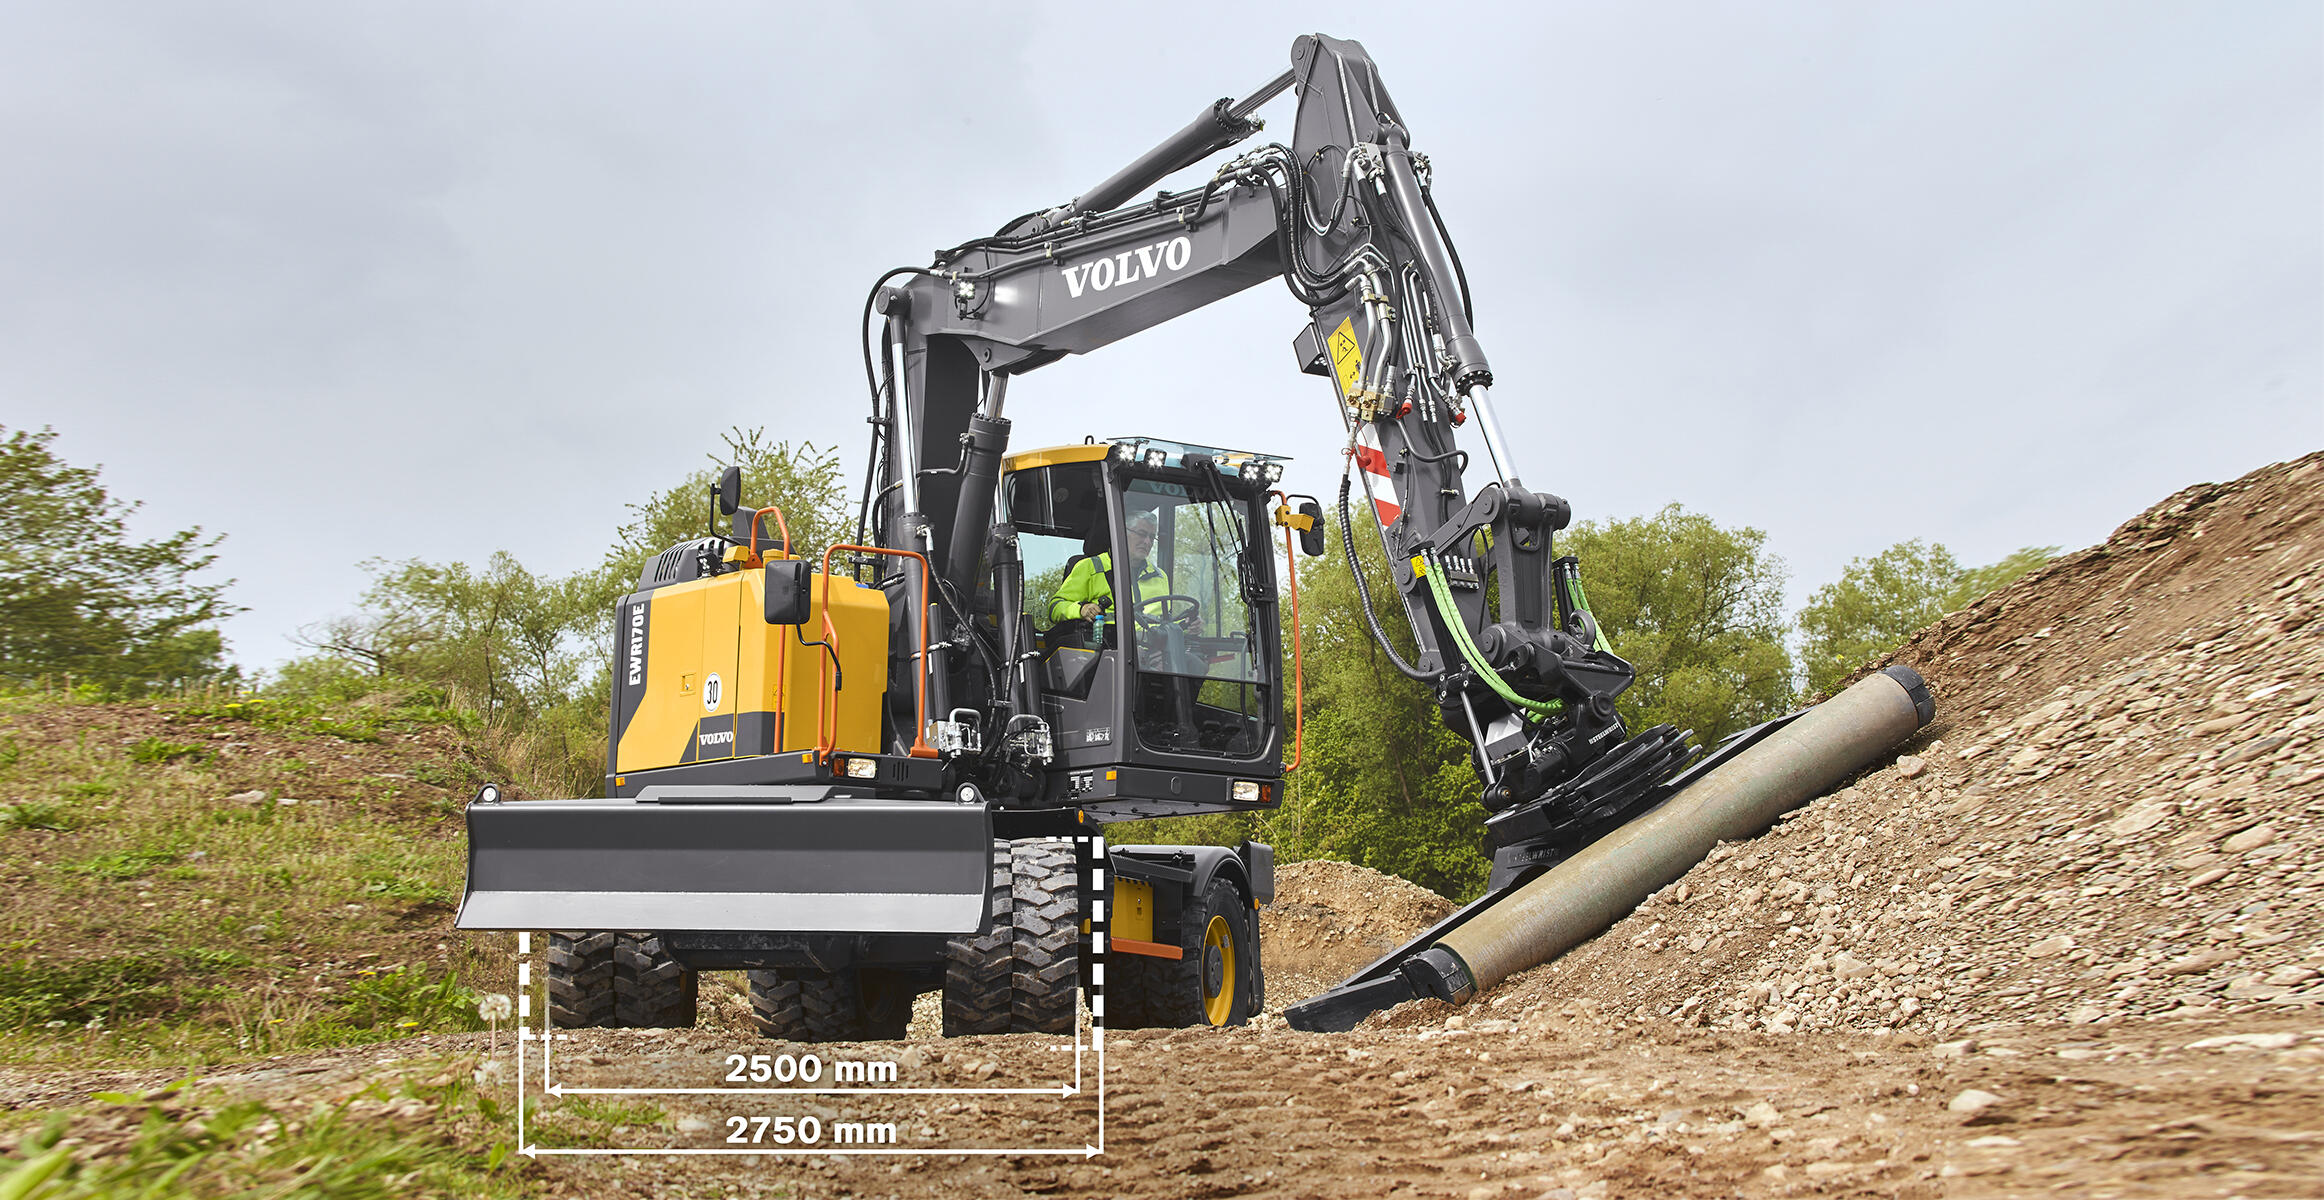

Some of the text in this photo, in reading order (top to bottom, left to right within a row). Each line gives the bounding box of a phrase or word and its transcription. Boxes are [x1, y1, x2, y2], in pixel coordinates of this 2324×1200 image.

[1062, 237, 1191, 298] VOLVO
[629, 603, 645, 686] EWR170E
[706, 680, 719, 705] 30
[699, 731, 734, 745] VOLVO
